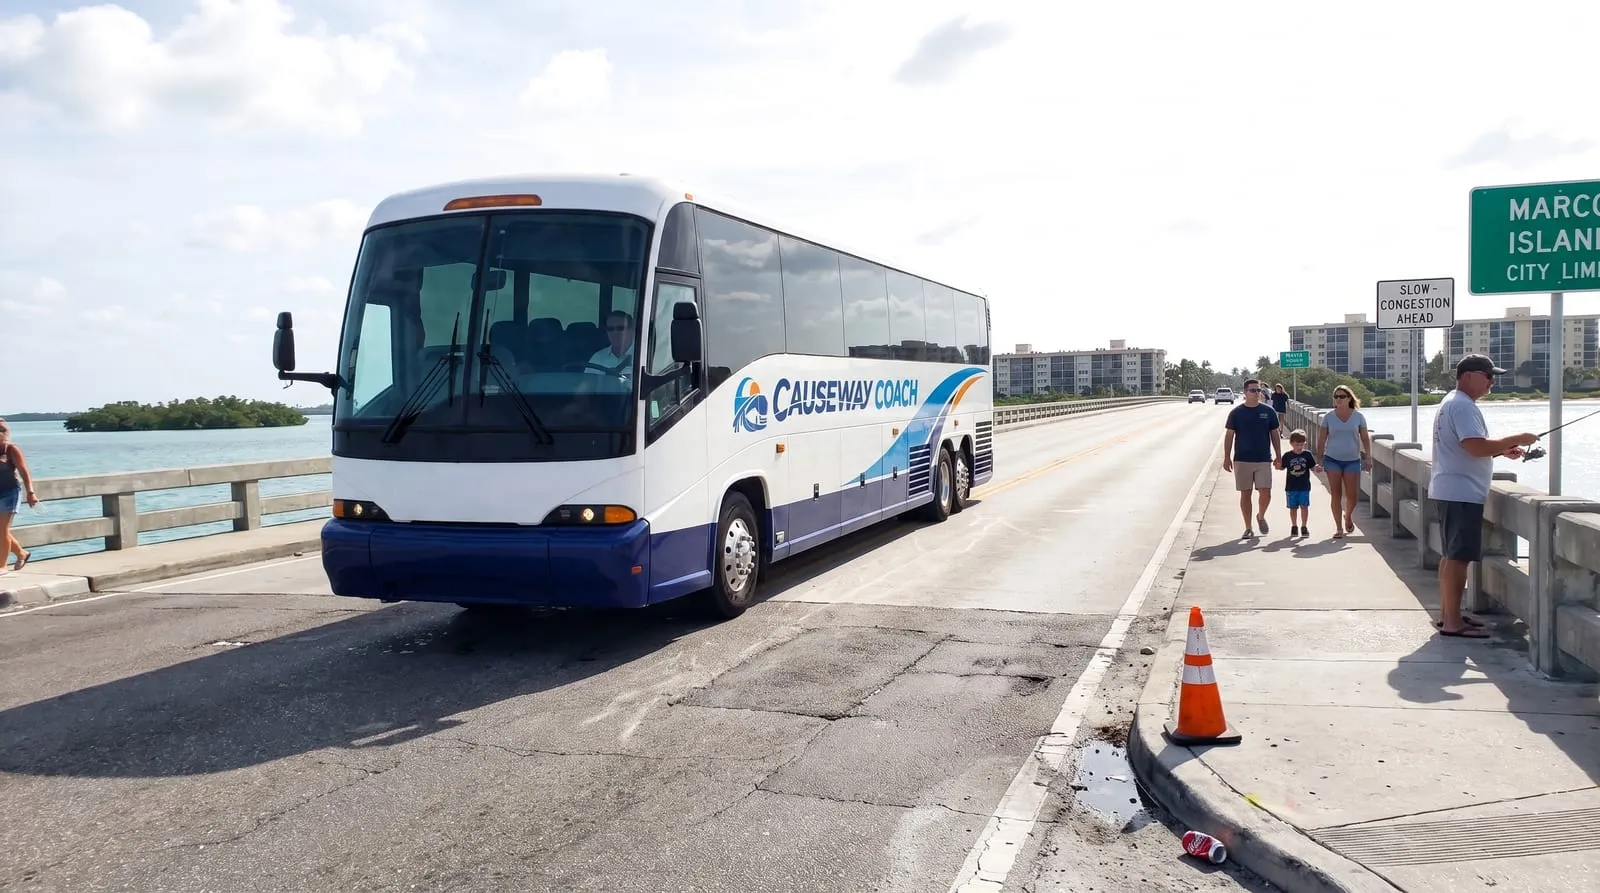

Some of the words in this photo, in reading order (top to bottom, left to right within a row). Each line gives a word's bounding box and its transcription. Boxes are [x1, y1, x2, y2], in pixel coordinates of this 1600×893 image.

[1509, 227, 1600, 254] ISLAN
[1506, 263, 1550, 281] CITY
[1380, 297, 1450, 310] CONGESTION
[1396, 313, 1434, 324] AHEAD
[773, 378, 873, 422] CAUSEWAY
[875, 379, 919, 410] COACH
